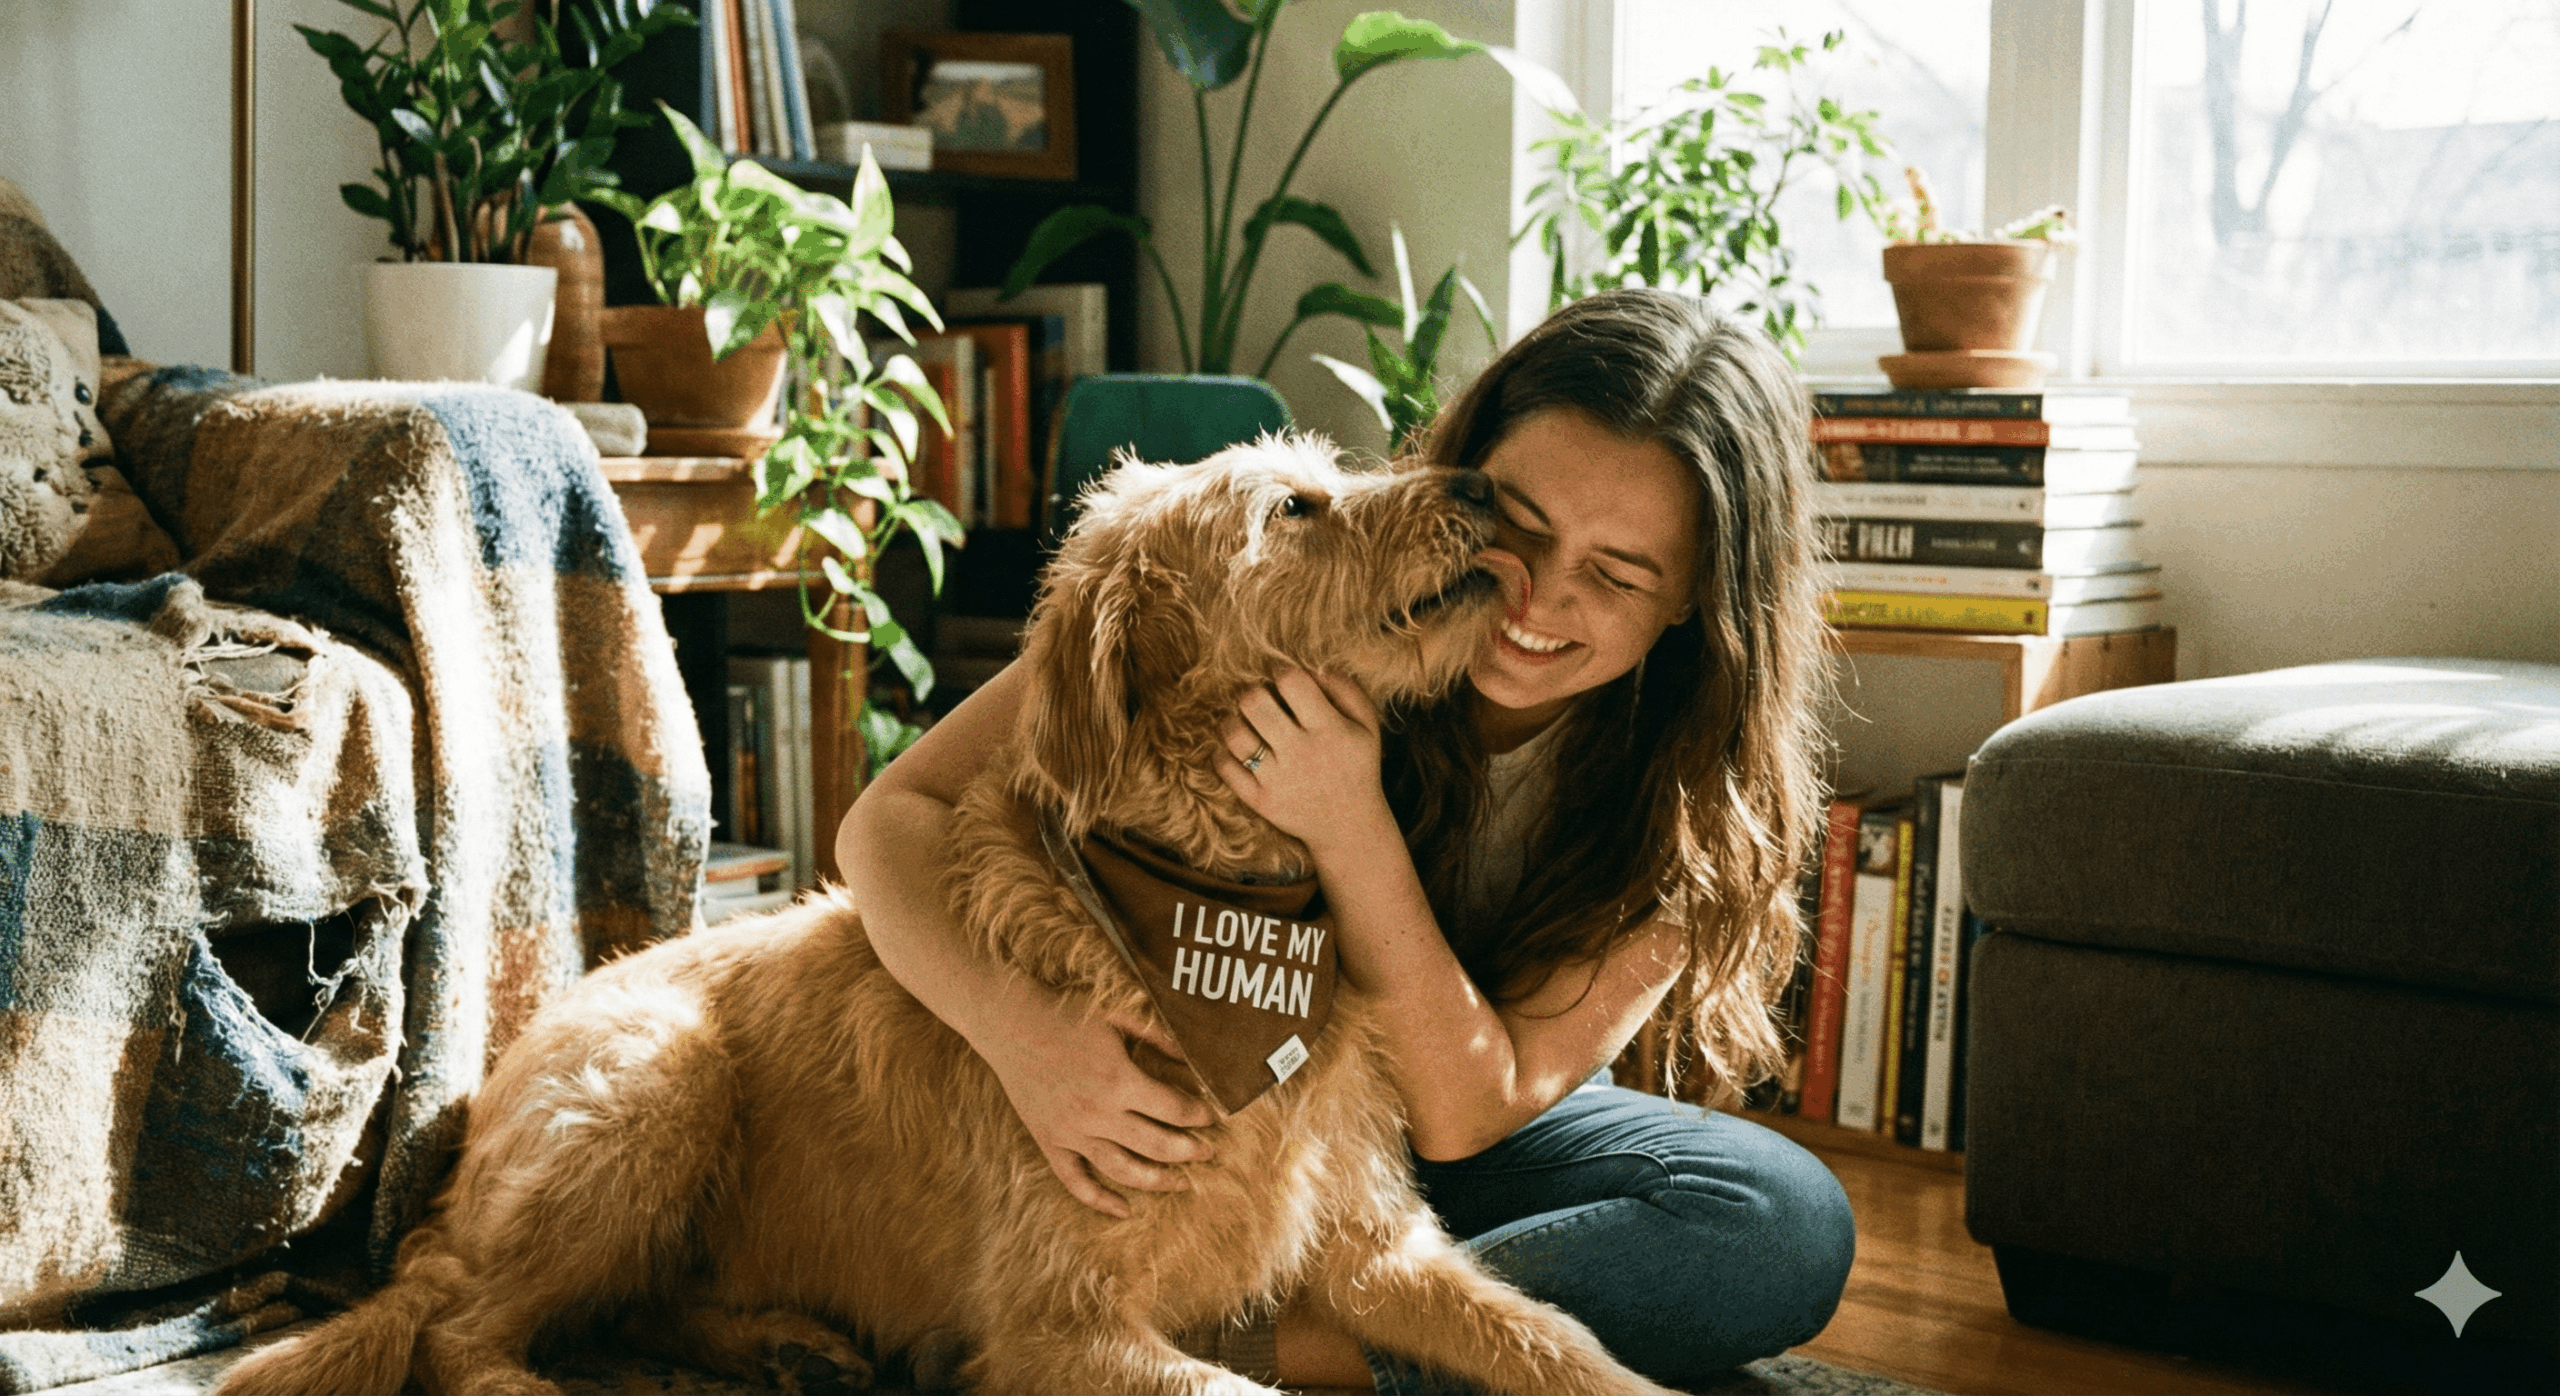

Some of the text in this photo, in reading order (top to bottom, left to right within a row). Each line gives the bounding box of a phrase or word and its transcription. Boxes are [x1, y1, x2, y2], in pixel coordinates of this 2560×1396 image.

[1173, 902, 1326, 966] I LOVE MY
[1171, 947, 1313, 1019] HUMAN
